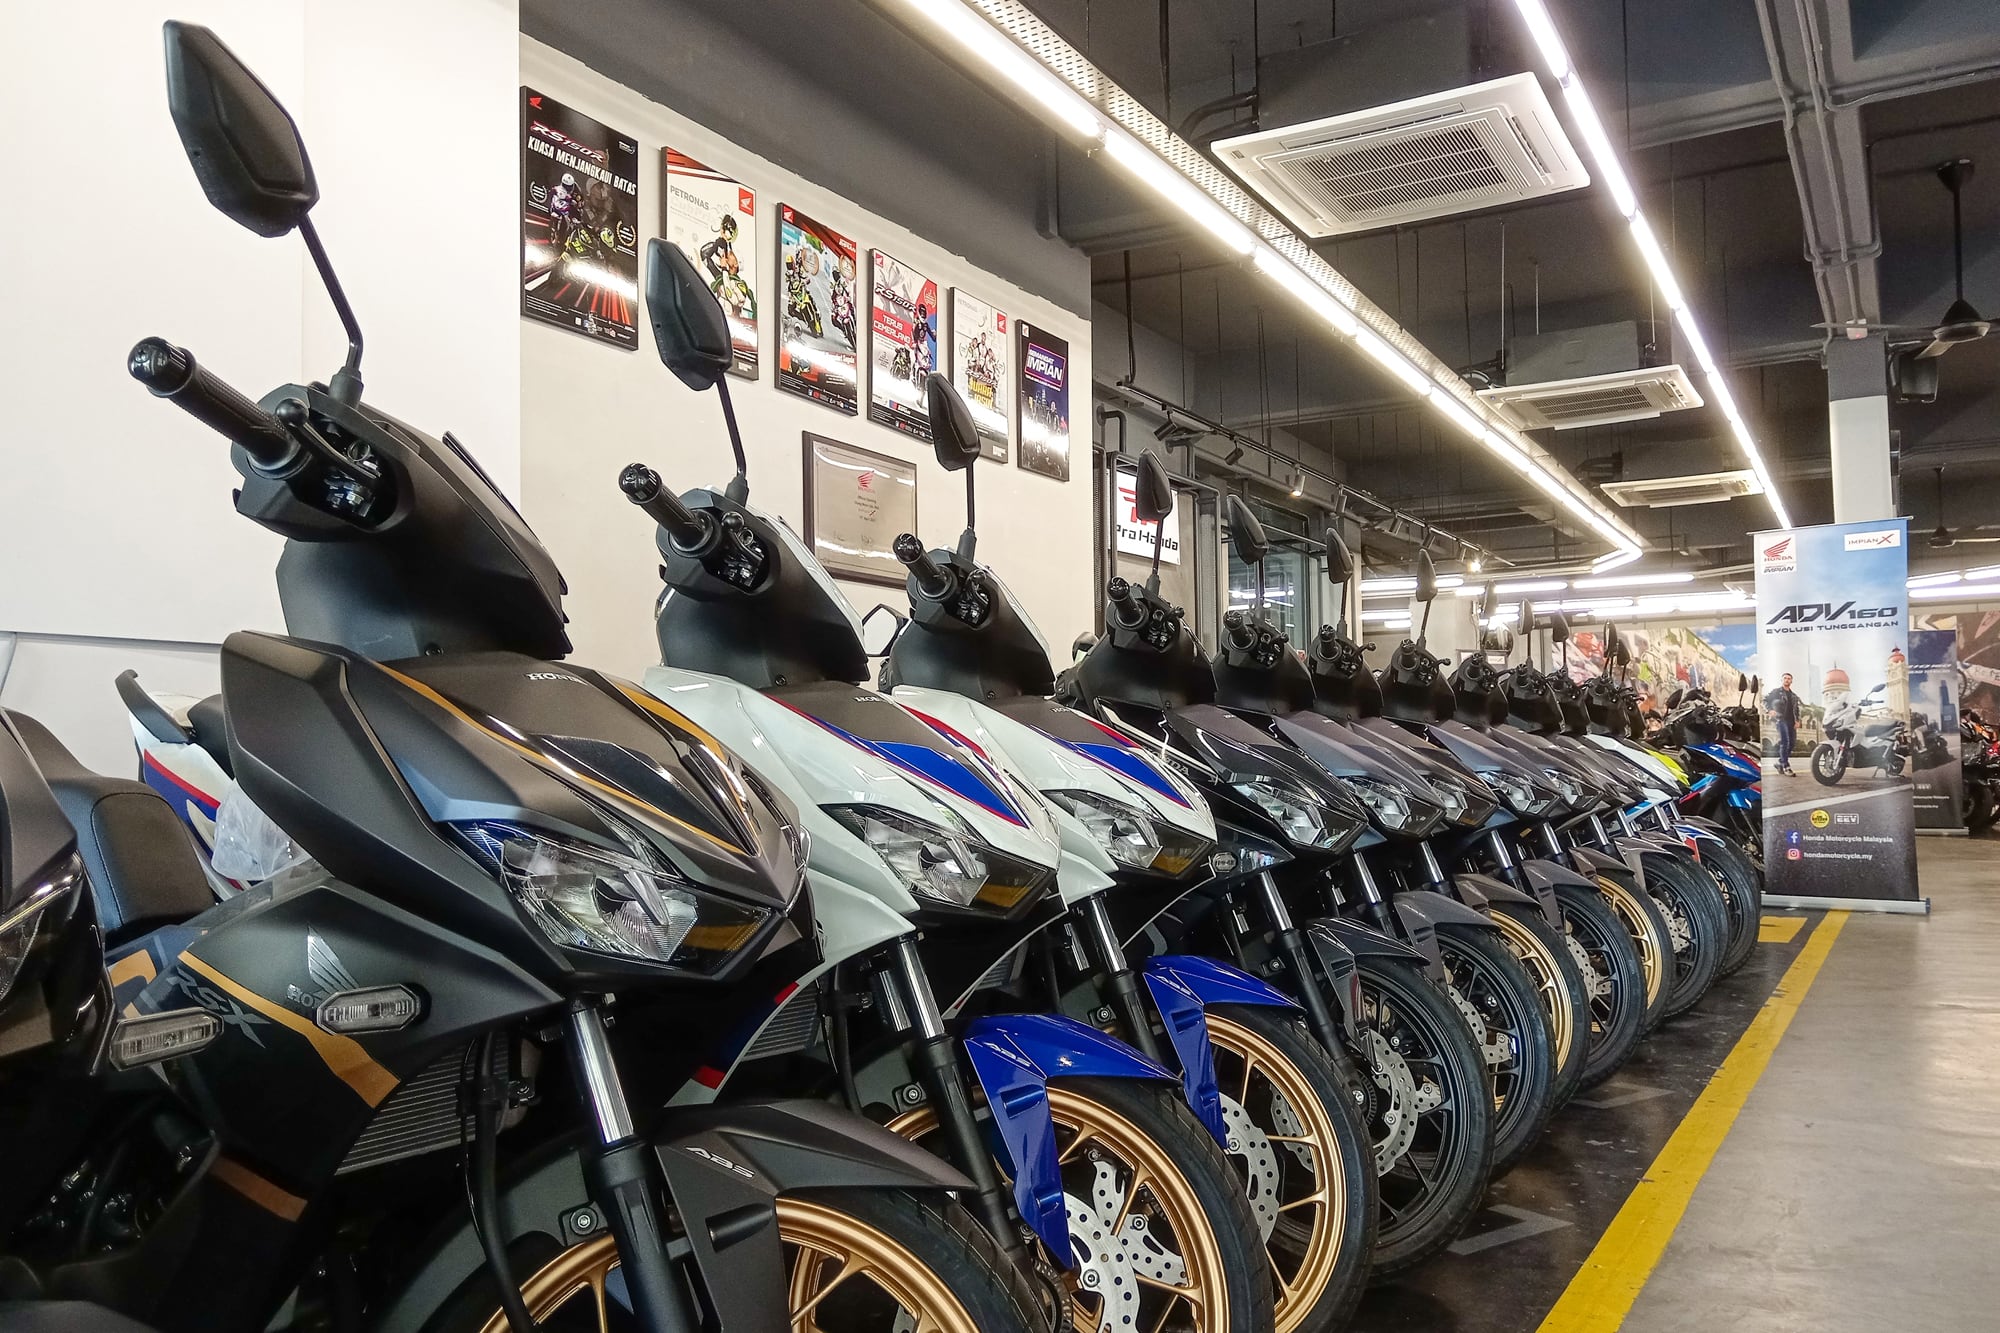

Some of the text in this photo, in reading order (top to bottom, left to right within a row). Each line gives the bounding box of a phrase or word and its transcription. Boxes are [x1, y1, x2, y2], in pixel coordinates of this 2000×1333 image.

[530, 120, 604, 162] RS150R
[527, 136, 637, 196] KUASA MENJANGKAUI BATAS
[670, 185, 710, 210] PETRONAS
[875, 282, 917, 314] RS150R
[882, 314, 903, 331] TERUS
[1027, 355, 1063, 381] IMPIAN
[1766, 620, 1899, 634] EVOLUSI TUNGGANGAN
[1825, 835, 1862, 843] Motorcycle
[1803, 852, 1873, 860] hondamotorcycle.my
[983, 1042, 1031, 1067] ABS
[685, 1147, 756, 1179] ABS
